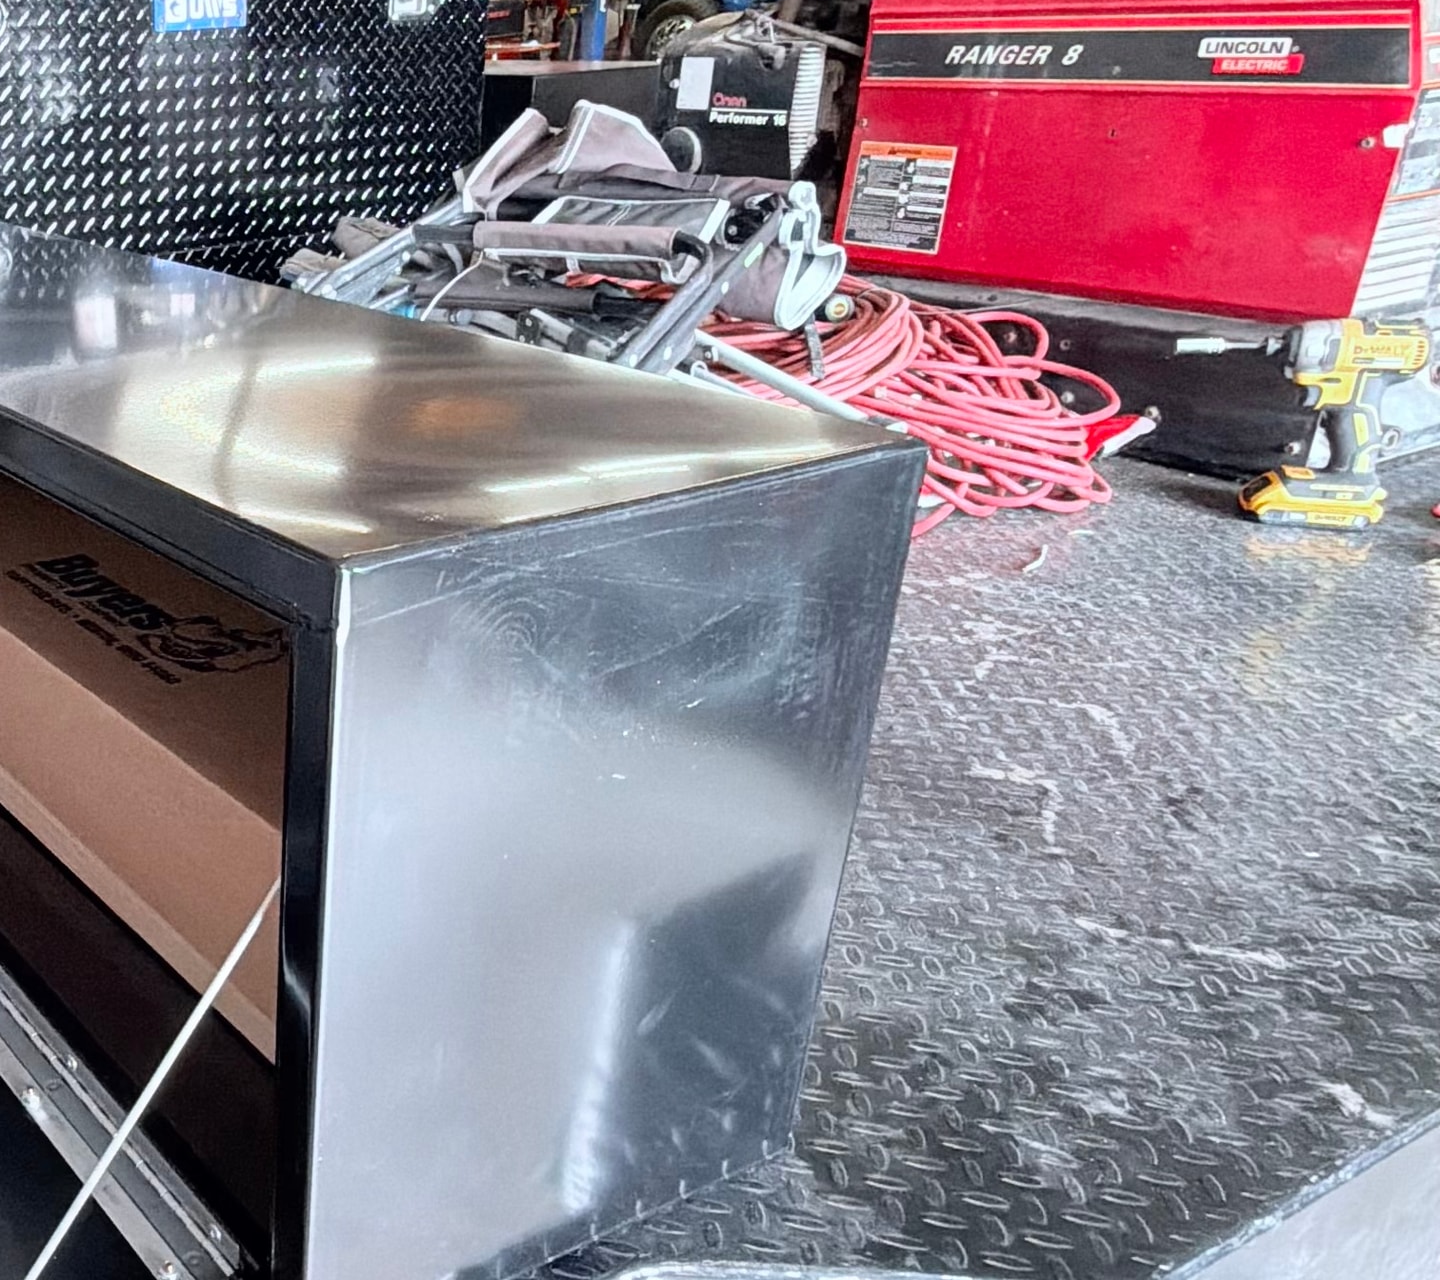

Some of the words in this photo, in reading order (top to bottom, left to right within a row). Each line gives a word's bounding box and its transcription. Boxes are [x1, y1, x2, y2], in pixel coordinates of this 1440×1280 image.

[945, 45, 1053, 66] RANGER
[1061, 44, 1085, 66] 8
[1205, 41, 1284, 55] LINCOLN
[1221, 59, 1288, 71] ELECTRIC
[709, 111, 769, 126] Performer
[773, 114, 787, 127] 16
[34, 553, 168, 631] Buyers
